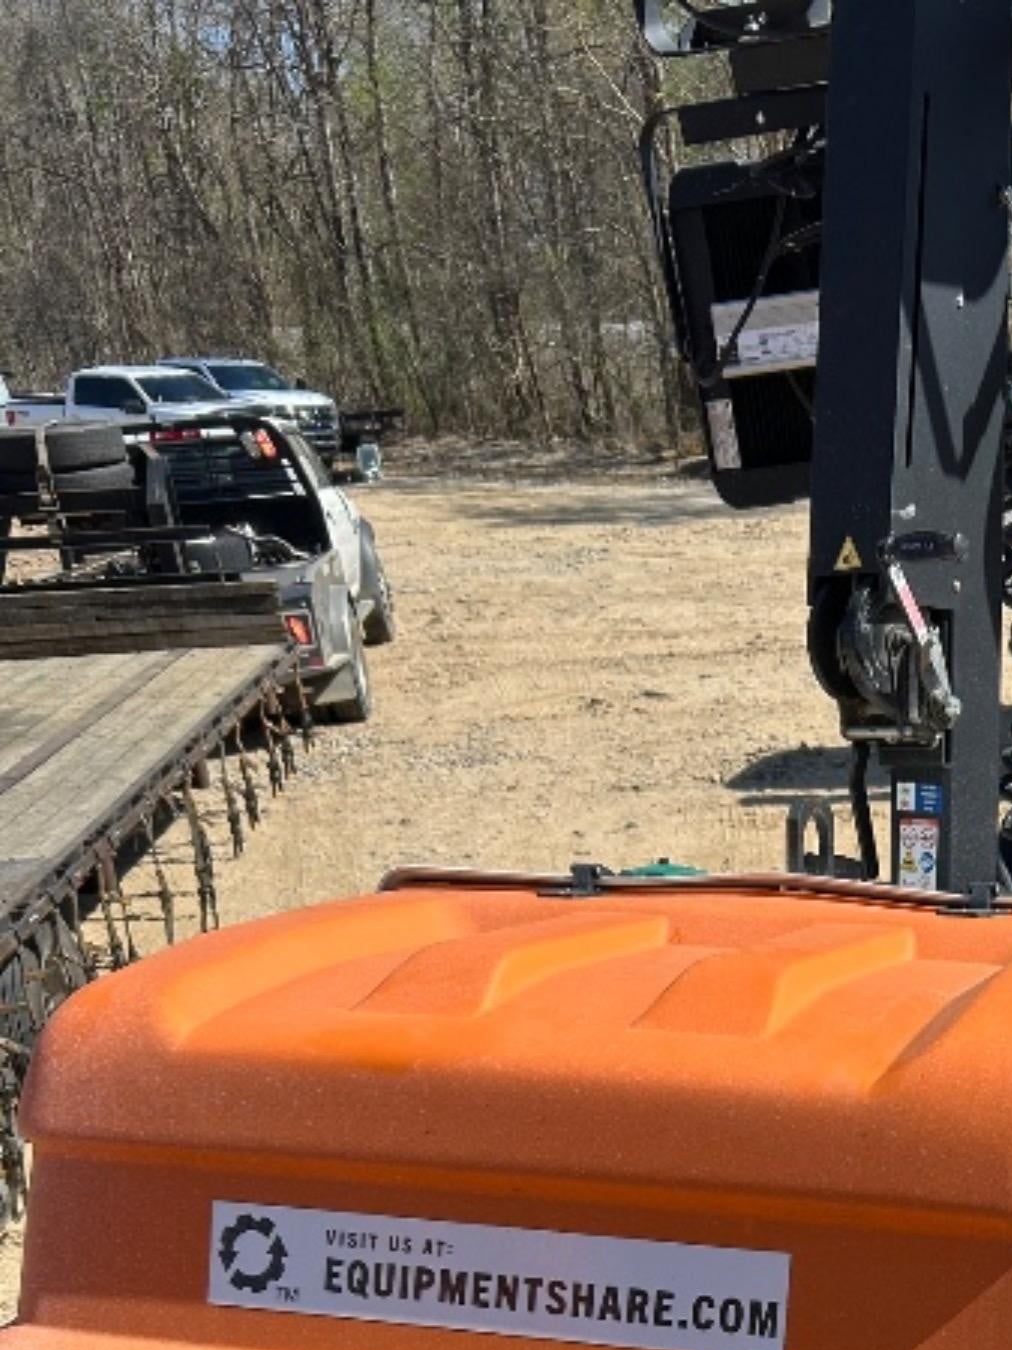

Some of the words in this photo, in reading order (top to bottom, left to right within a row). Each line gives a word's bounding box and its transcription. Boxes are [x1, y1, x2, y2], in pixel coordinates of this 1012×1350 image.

[325, 1229, 379, 1252] VISIT
[388, 1234, 412, 1253] US
[421, 1238, 455, 1257] AT:
[275, 1286, 301, 1302] TM
[324, 1256, 780, 1339] EQUIPMENTSHARE.COM
